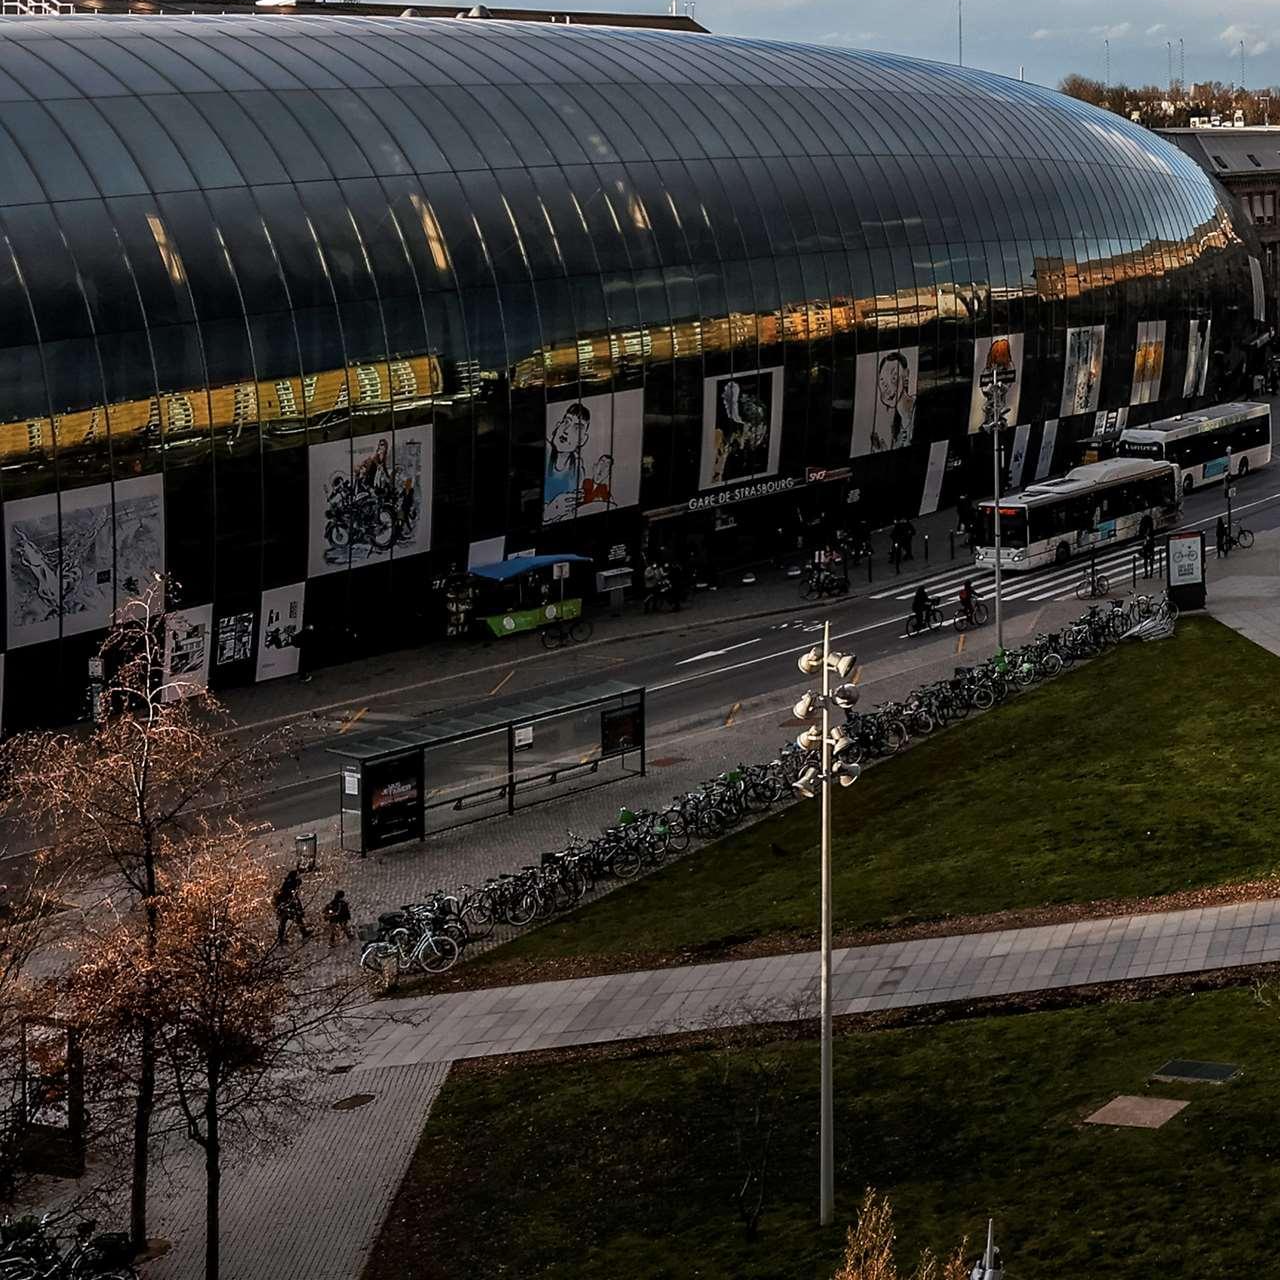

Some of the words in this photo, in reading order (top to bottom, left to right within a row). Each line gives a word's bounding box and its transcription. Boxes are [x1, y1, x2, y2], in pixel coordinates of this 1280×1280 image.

[688, 493, 715, 510] GARE
[718, 490, 732, 504] DE
[734, 477, 794, 501] STRASBOURG
